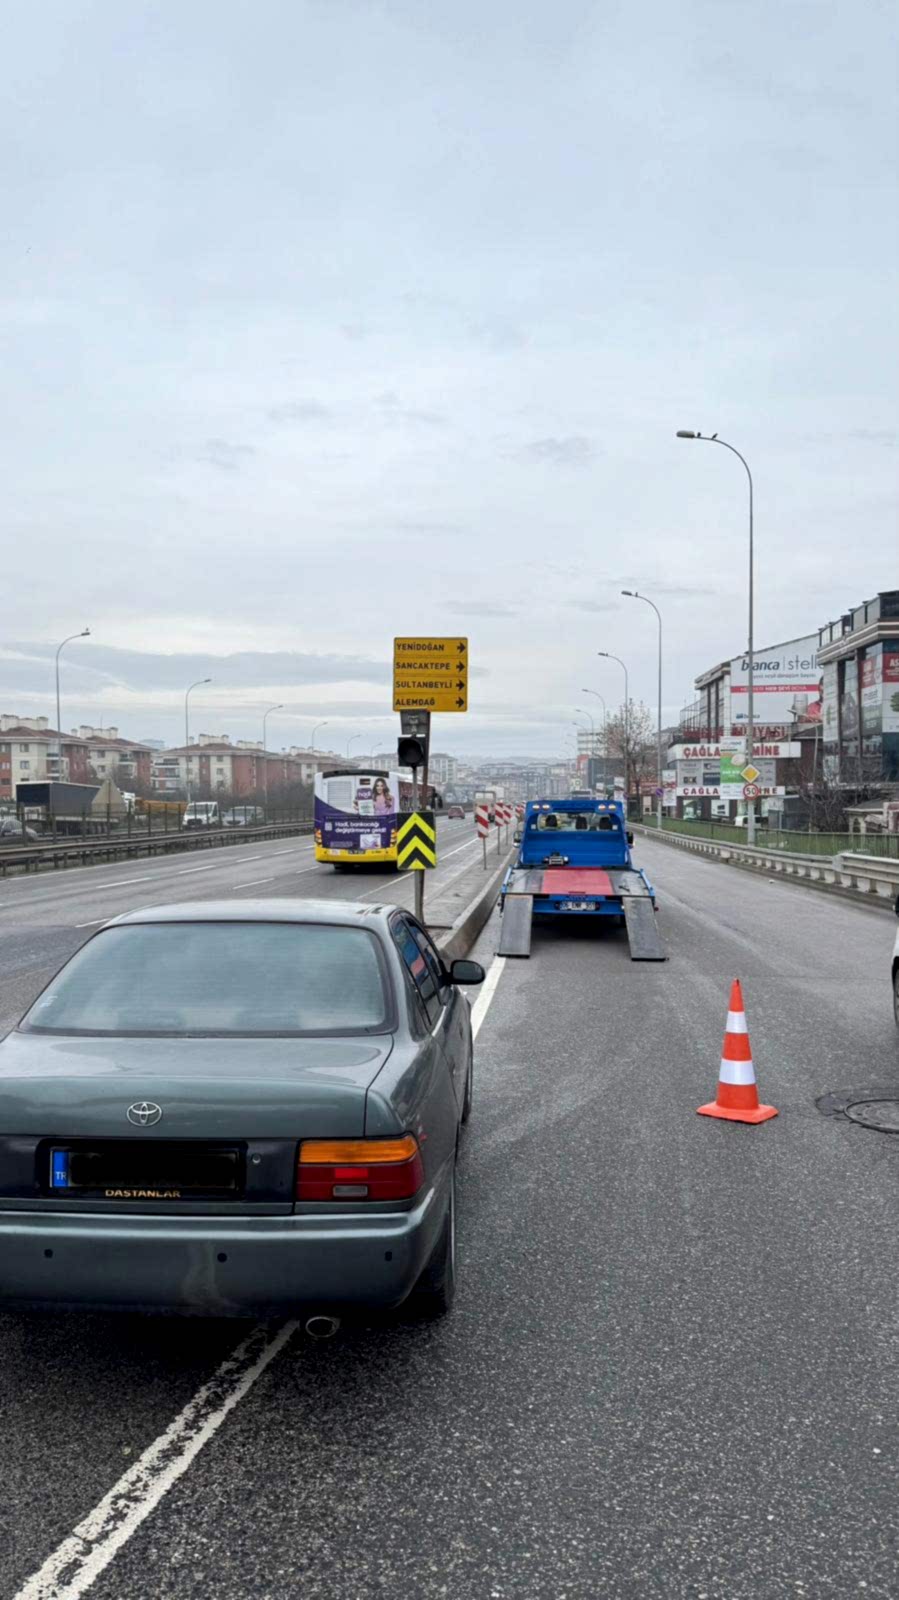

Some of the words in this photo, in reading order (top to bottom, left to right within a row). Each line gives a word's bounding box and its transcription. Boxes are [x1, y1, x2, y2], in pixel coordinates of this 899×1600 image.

[396, 643, 445, 651] YENİDOĞAN
[395, 662, 451, 671] SANCAKTEPE
[741, 659, 780, 671] banca
[395, 680, 453, 689] SULTANBEYLİ
[395, 697, 435, 706] ALEMDAĞ
[746, 787, 756, 796] 50
[55, 1171, 67, 1181] TR
[105, 1189, 181, 1198] DASTANLAR
